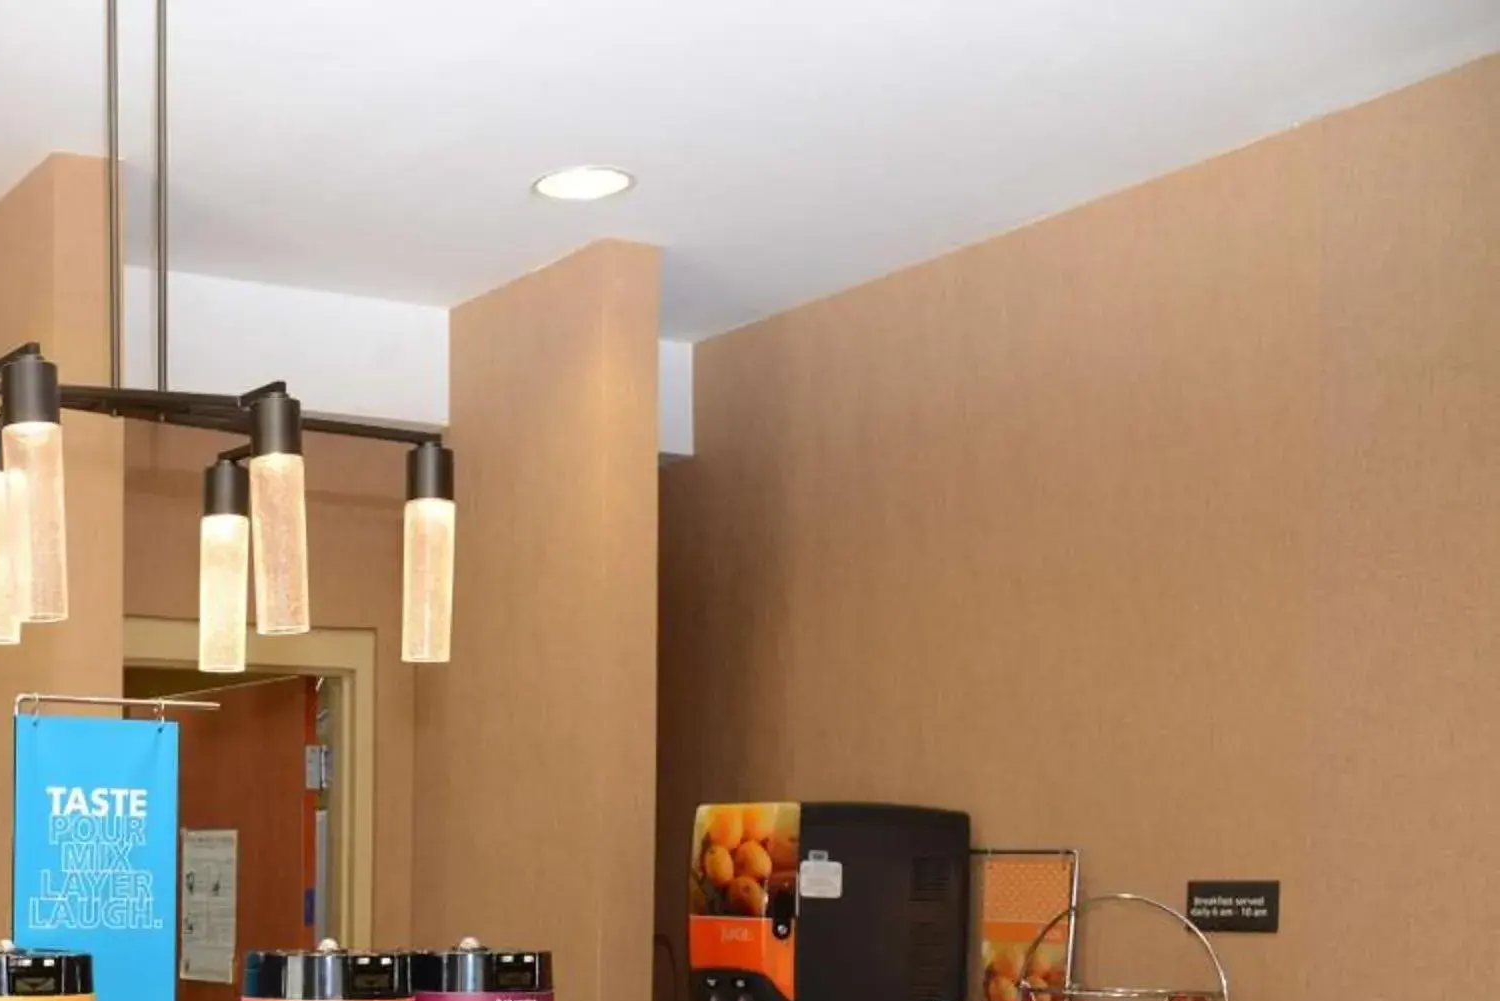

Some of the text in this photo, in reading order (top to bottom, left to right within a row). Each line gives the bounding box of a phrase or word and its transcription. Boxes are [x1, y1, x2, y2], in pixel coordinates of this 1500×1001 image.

[46, 786, 148, 817] TASTE
[49, 814, 147, 845] POUR
[61, 841, 133, 872] MIX
[41, 869, 154, 901] LAYER
[29, 897, 164, 929] LAUGH.
[1190, 907, 1211, 918] daily
[1219, 908, 1234, 917] am
[1253, 908, 1268, 917] am
[1193, 896, 1265, 906] Breakfast served
